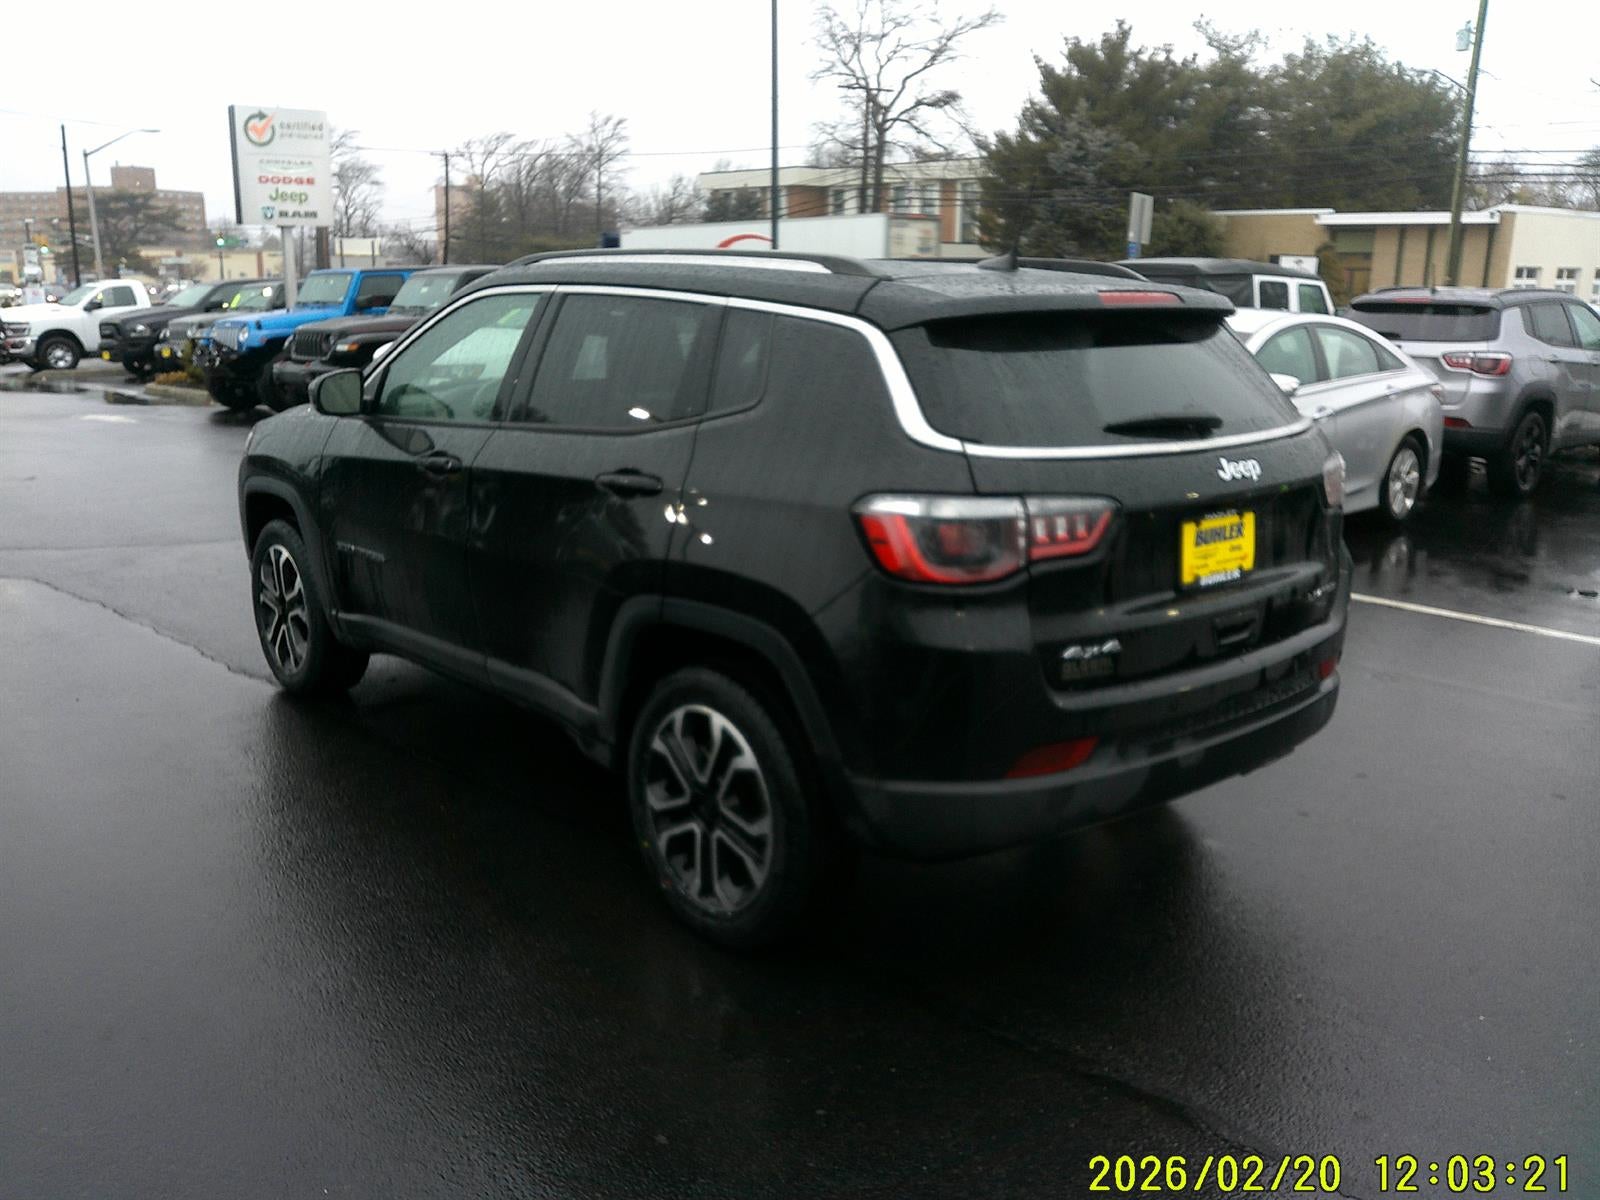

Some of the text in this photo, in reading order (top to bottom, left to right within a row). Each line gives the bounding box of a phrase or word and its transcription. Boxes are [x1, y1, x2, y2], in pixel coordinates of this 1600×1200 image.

[258, 175, 315, 185] DODGE
[269, 187, 308, 205] Jeep
[1216, 456, 1262, 482] Jeep
[1195, 519, 1245, 547] BUHLER
